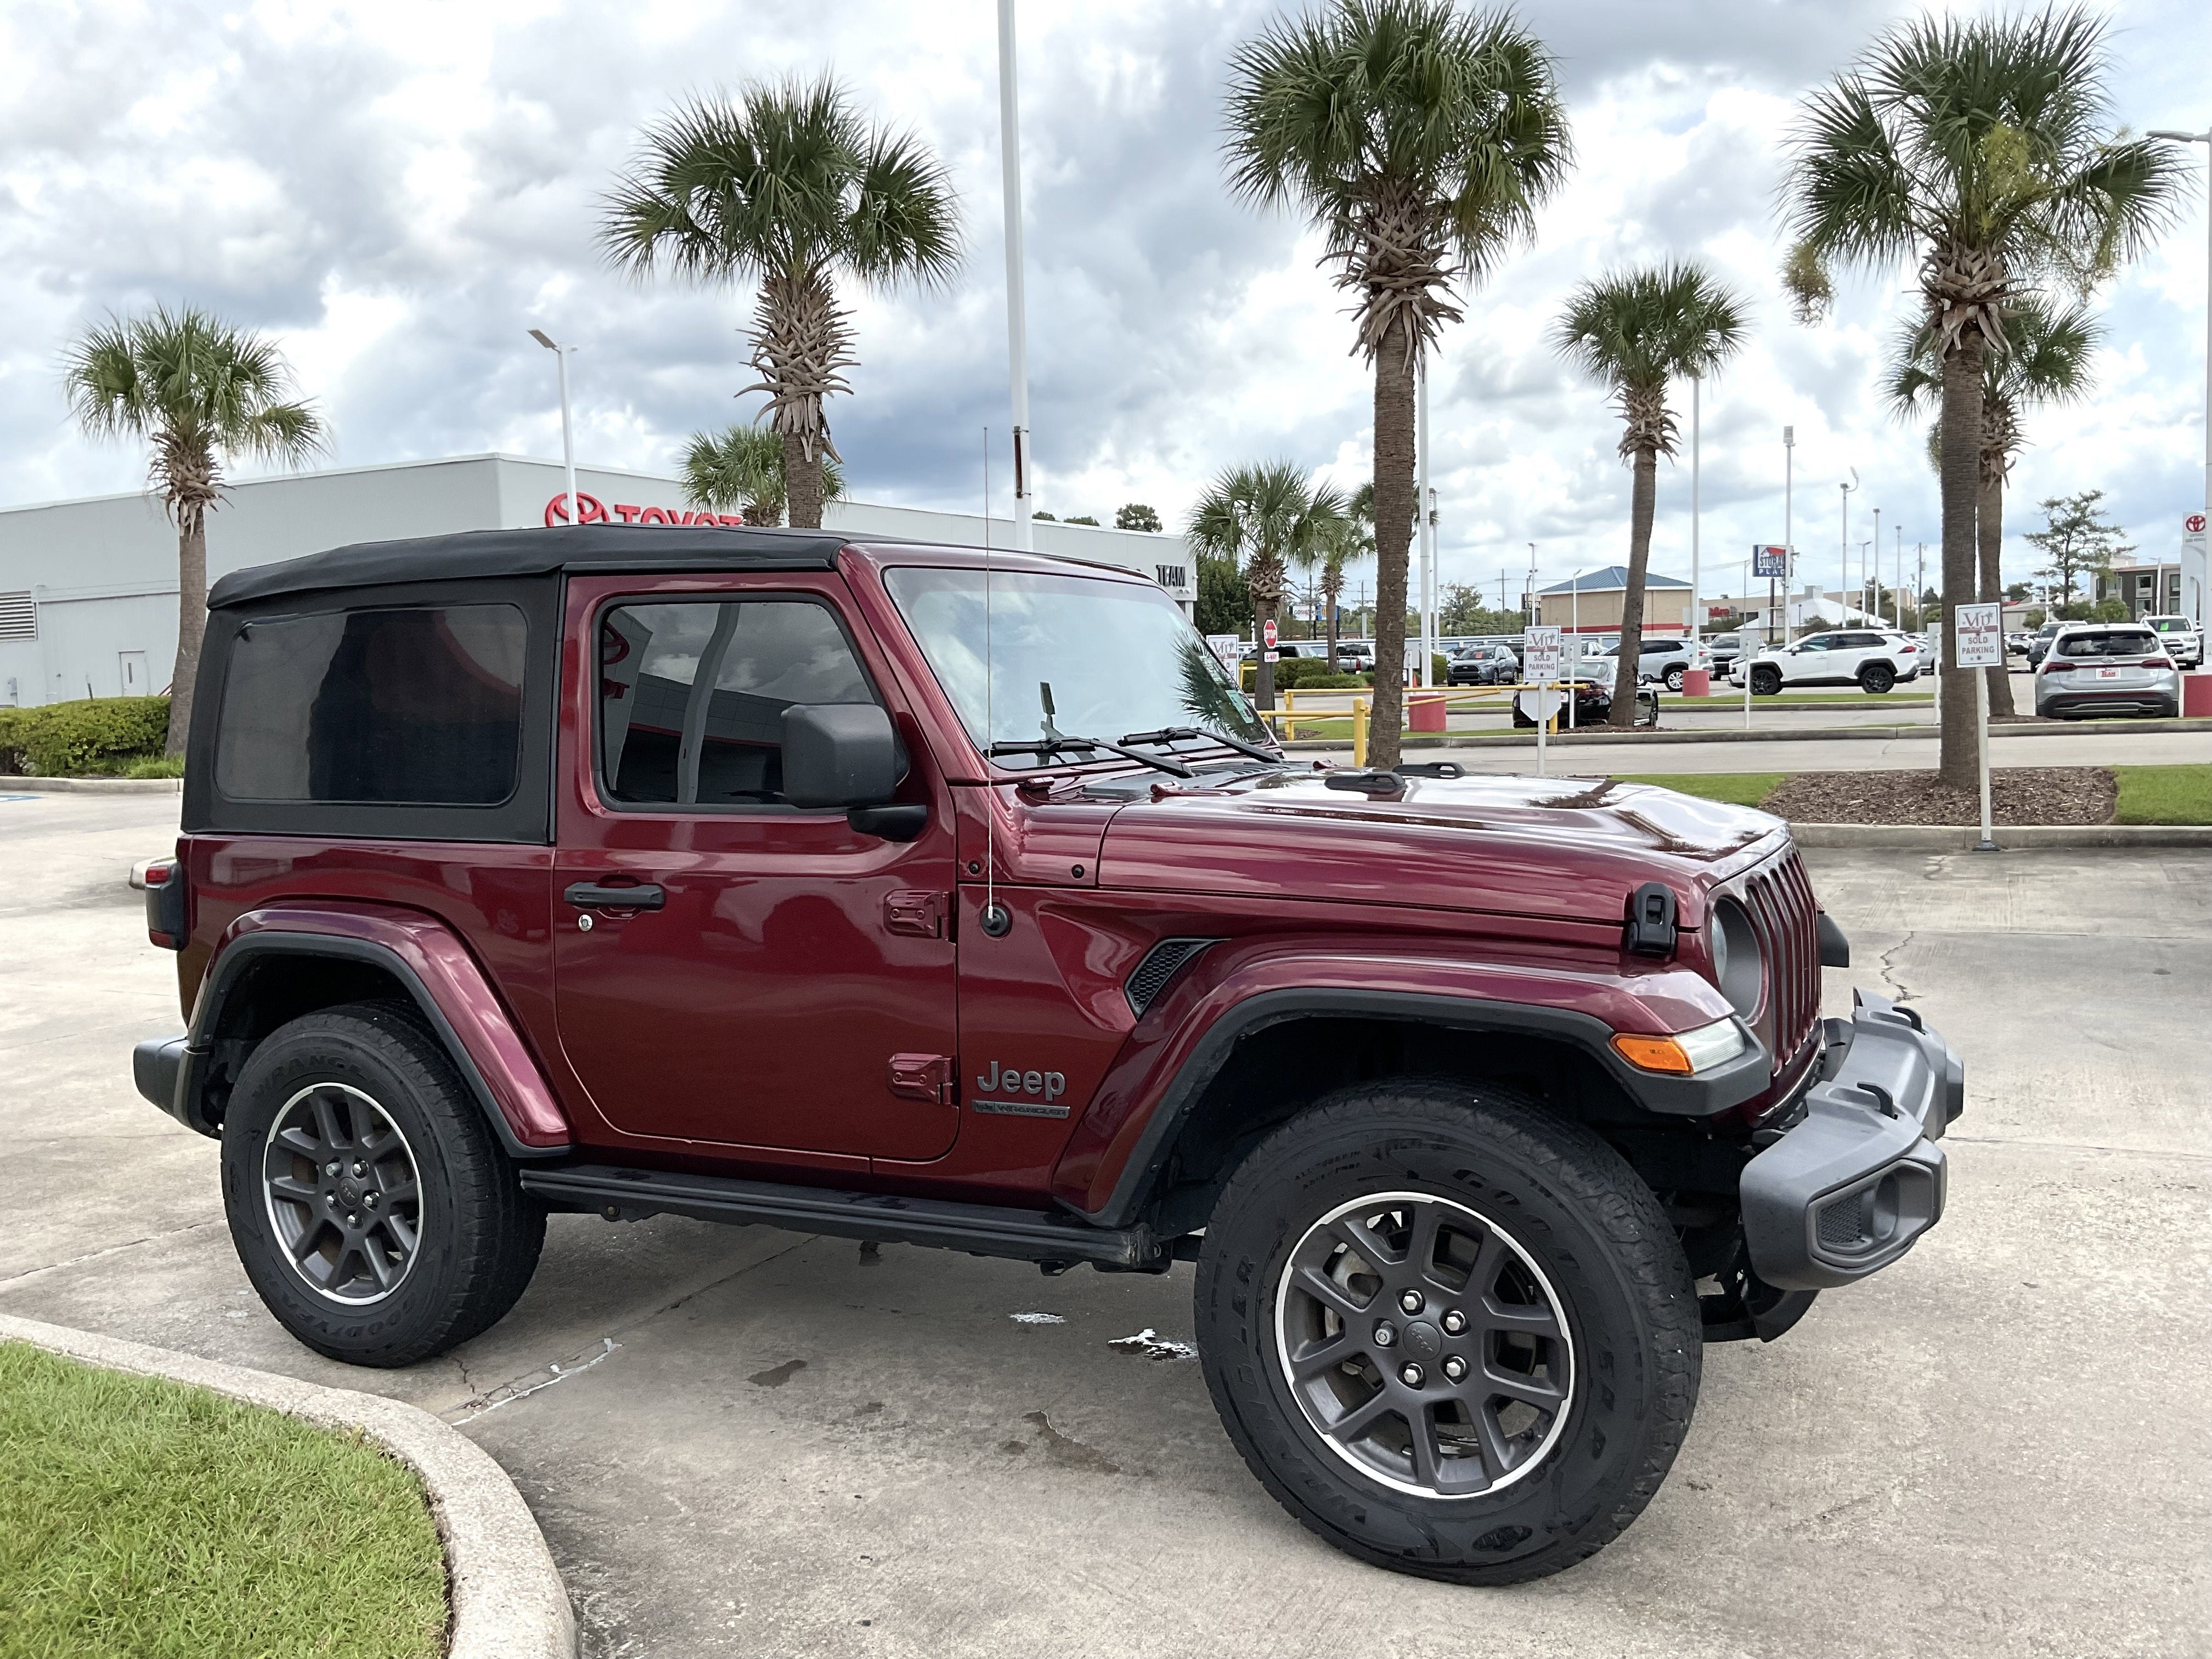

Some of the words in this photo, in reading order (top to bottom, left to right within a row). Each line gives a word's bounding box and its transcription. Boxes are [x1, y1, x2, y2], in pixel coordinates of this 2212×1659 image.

[614, 504, 742, 526] TOYO
[1760, 556, 1784, 567] STORA
[1156, 565, 1186, 586] TEAM
[1265, 629, 1276, 639] STOP
[1968, 636, 1988, 645] SOLD
[1962, 646, 1995, 654] PARKING
[977, 1060, 1066, 1102] Jeep
[995, 1104, 1067, 1116] WRANGLER
